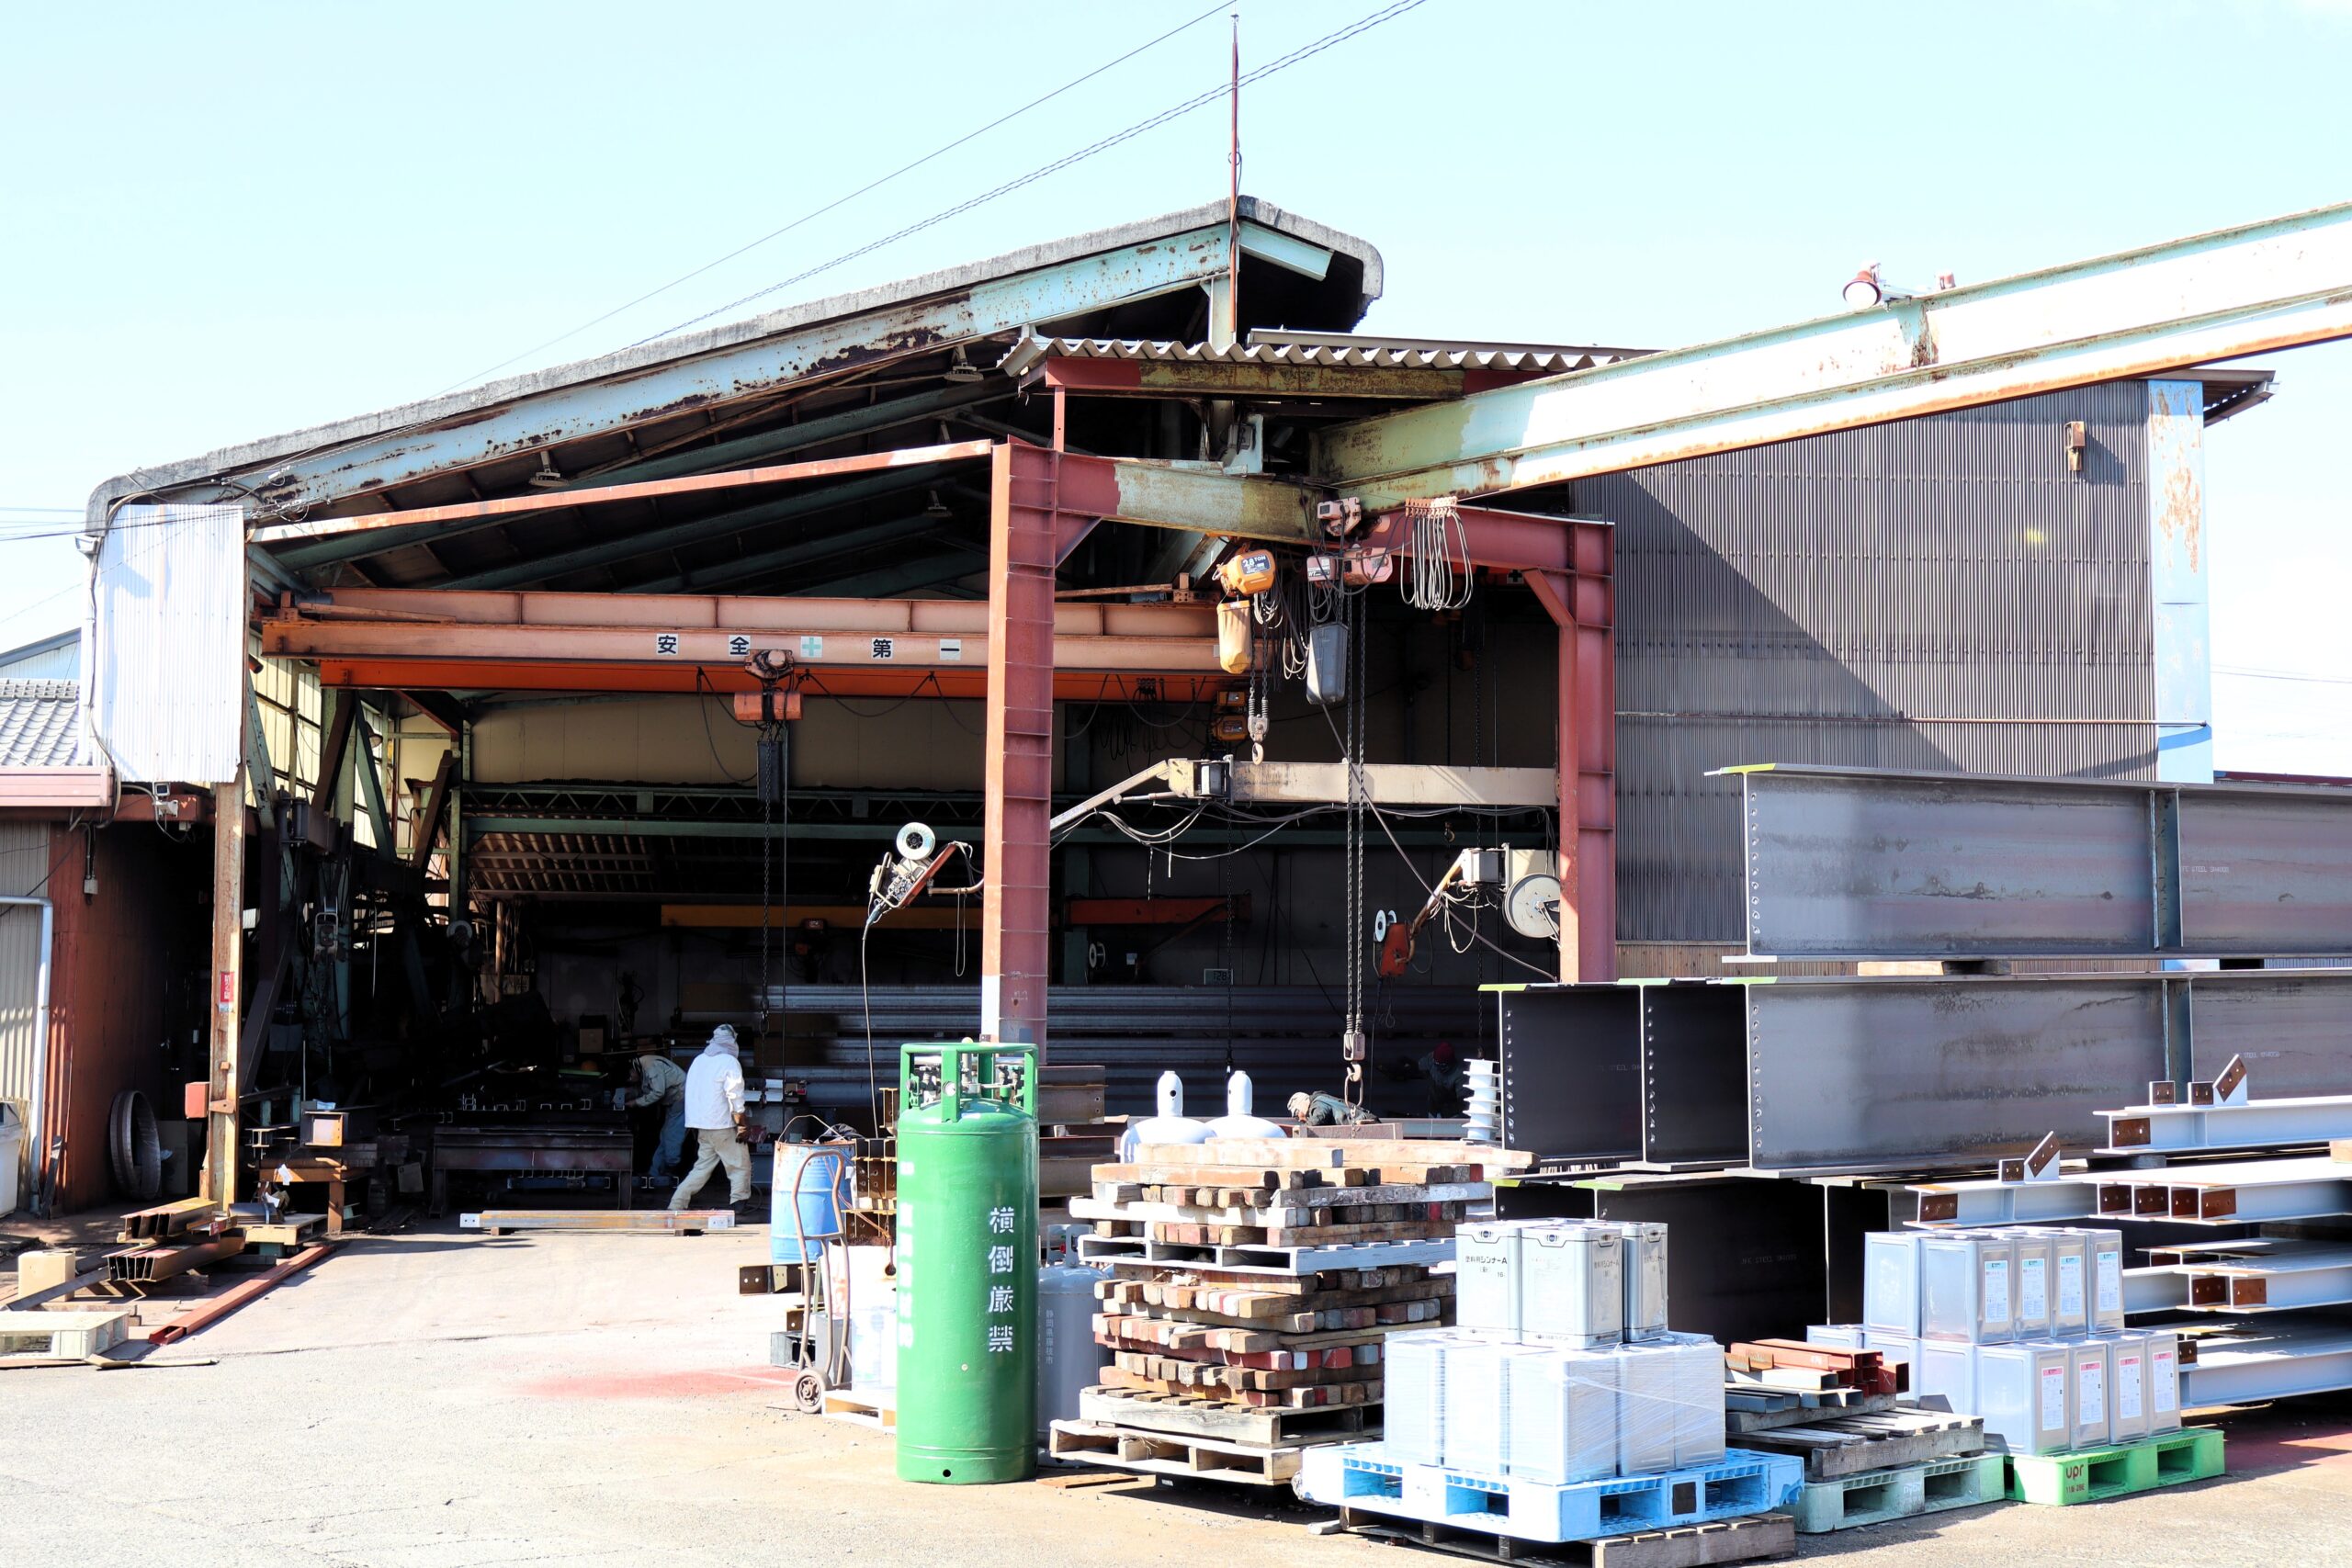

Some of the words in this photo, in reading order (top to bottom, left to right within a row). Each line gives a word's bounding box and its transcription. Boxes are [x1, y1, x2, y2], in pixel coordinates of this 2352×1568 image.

[988, 1206, 1015, 1352] 横倒厳禁
[2065, 1464, 2085, 1481] upr
